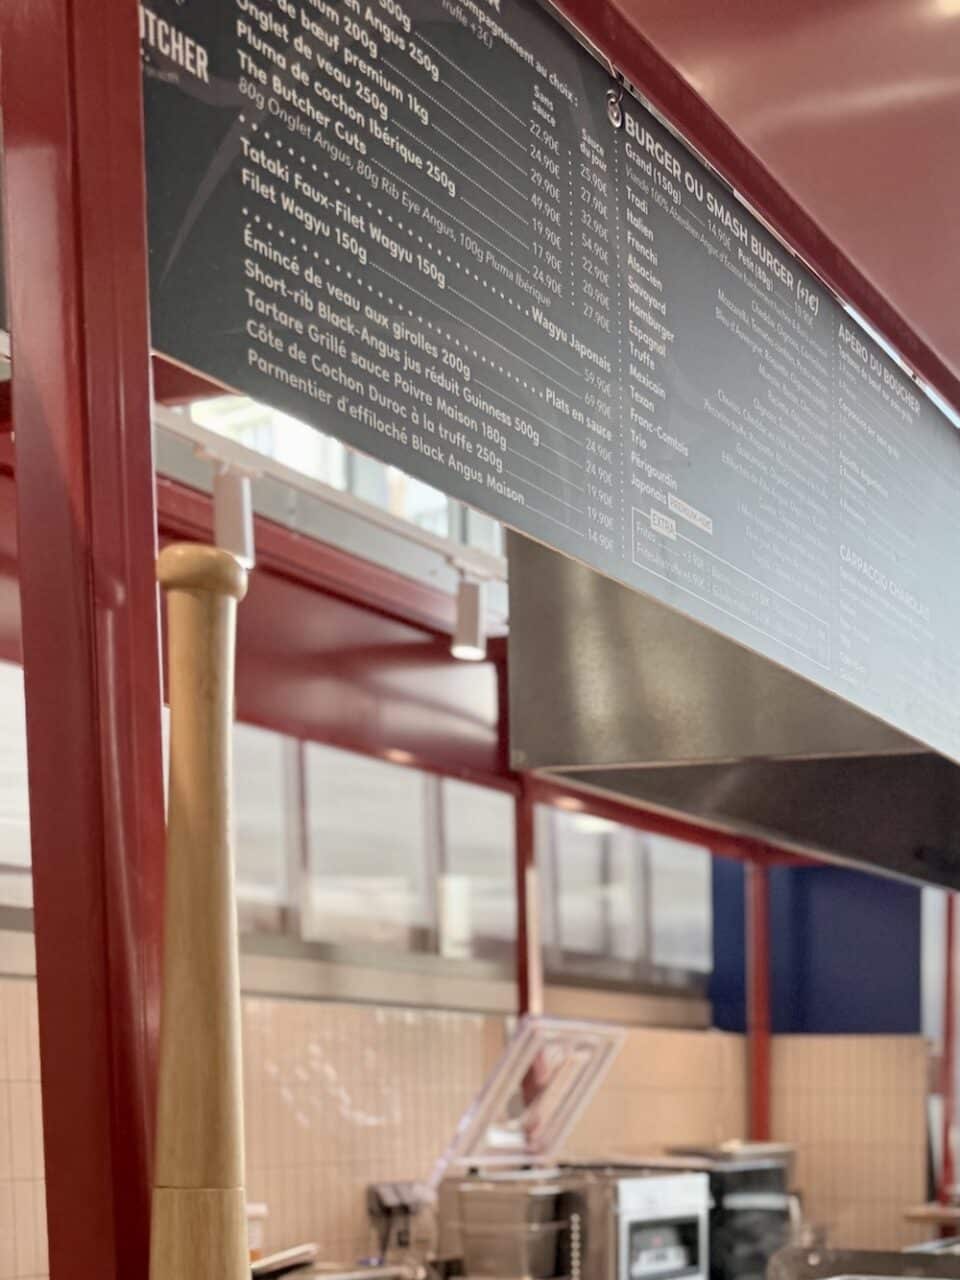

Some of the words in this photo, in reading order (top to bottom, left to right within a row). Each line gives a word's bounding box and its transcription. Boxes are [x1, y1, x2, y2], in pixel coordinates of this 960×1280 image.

[237, 0, 288, 42] Onglet
[293, 35, 312, 60] de
[316, 53, 350, 88] veau
[355, 80, 388, 120] 250g
[532, 217, 562, 250] 19.90€
[301, 8, 339, 51] bœuf
[344, 48, 403, 102] premium
[408, 93, 429, 126] 1kg
[531, 193, 561, 226] 49.90€
[344, 18, 377, 58] 200g
[531, 168, 561, 203] 29.90€
[365, 7, 405, 50] Angus
[409, 42, 439, 82] 250g
[530, 144, 560, 179] 24.90€
[236, 19, 286, 69] Pluma
[291, 63, 309, 86] de
[314, 81, 365, 126] cochon
[369, 118, 422, 169] Ibérique
[427, 160, 456, 197] 250g
[532, 242, 562, 274] 17.90€
[529, 120, 560, 156] 22.90€
[237, 49, 267, 85] The
[272, 75, 330, 128] Butcher
[335, 122, 367, 154] Cuts
[533, 265, 563, 298] 24.90€
[238, 76, 264, 110] 80g
[268, 98, 312, 139] Onglet
[314, 131, 353, 170] Angus,
[357, 160, 379, 189] 80g
[381, 177, 399, 200] Rib
[402, 191, 421, 215] Eye
[459, 232, 484, 263] 100g
[486, 251, 514, 281] Pluma
[624, 112, 681, 182] BURGER
[685, 171, 704, 202] OU
[706, 192, 748, 247] SMASH
[750, 235, 794, 291] BURGER
[625, 143, 652, 177] Grand
[654, 167, 681, 206] (150g)
[626, 186, 648, 215] Tradi
[240, 136, 289, 183] Tataki
[294, 173, 366, 233] Faux-Filet
[369, 223, 413, 263] Wagyu
[416, 254, 445, 290] 150g
[241, 167, 277, 204] Filet
[281, 193, 330, 236] Wagyu
[335, 228, 367, 265] 150g
[626, 208, 654, 241] Italien
[627, 231, 658, 266] Frenchi
[627, 253, 663, 291] Alsacien
[243, 223, 300, 276] Émincé
[304, 266, 323, 288] de
[326, 282, 360, 312] veau
[364, 304, 389, 329] aux
[392, 321, 438, 359] girolles
[441, 349, 470, 381] 200g
[628, 275, 666, 315] Savoyard
[628, 297, 674, 343] Hamburger
[244, 258, 314, 312] Short-rib
[318, 301, 400, 362] Black-Angus
[403, 351, 421, 375] jus
[424, 366, 460, 398] réduit
[463, 387, 513, 427] Guinness
[514, 417, 540, 447] 500g
[244, 288, 304, 334] Tartare
[308, 324, 347, 358] Grillé
[351, 351, 390, 382] sauce
[394, 372, 433, 406] Poivre
[436, 396, 479, 432] Maison
[481, 422, 507, 451] 180g
[531, 305, 567, 342] Wagyu
[569, 334, 612, 373] Japonais
[629, 319, 666, 358] Espagnol
[629, 341, 655, 370] Truffe
[870, 352, 882, 377] DU
[246, 319, 284, 352] Côte
[288, 343, 307, 365] de
[311, 354, 364, 397] Cochon
[368, 385, 408, 419] Duroc
[411, 405, 420, 425] à
[423, 412, 435, 433] la
[438, 423, 473, 454] truffe
[476, 443, 503, 473] 250g
[545, 388, 570, 415] Plats
[572, 408, 584, 425] en
[586, 417, 612, 441] sauce
[629, 363, 666, 400] Mexicain
[630, 385, 655, 413] Texan
[248, 348, 333, 406] Parmentier
[337, 396, 408, 444] d'effiloché
[412, 434, 445, 465] Black
[448, 454, 484, 484] Angus
[486, 474, 525, 505] Maison
[630, 429, 647, 449] Trio
